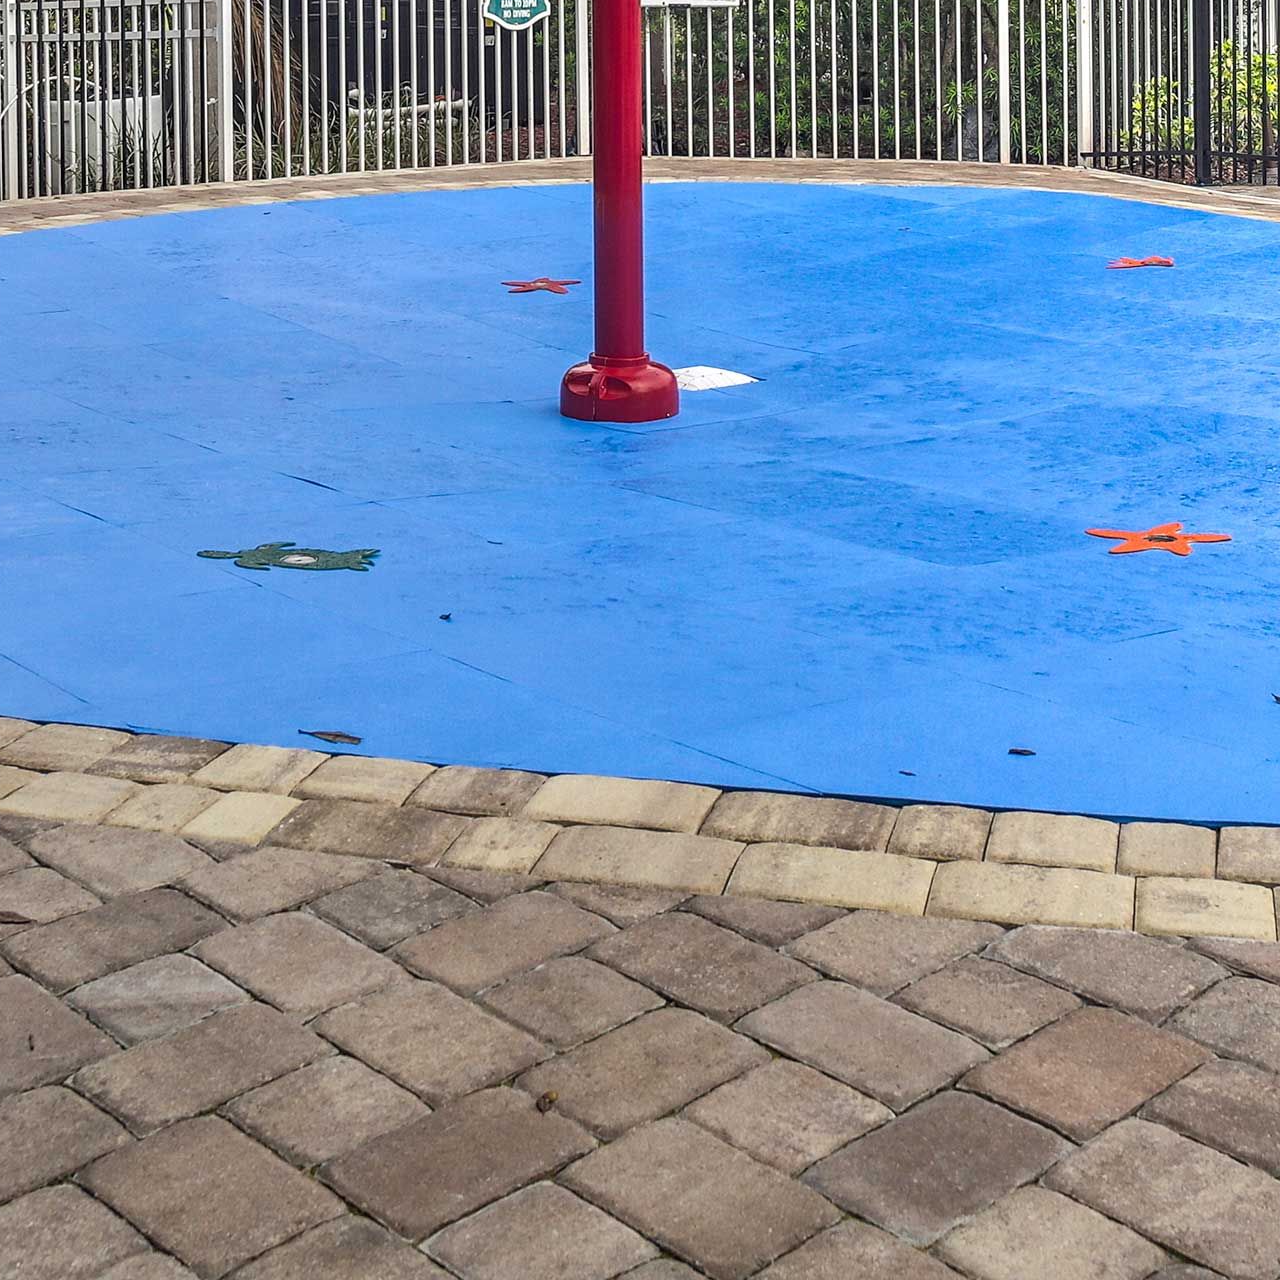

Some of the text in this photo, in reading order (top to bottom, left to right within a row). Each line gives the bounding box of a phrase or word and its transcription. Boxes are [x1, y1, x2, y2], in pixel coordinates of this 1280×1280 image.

[515, 0, 522, 8] TO
[504, 10, 530, 18] NO DIVING
